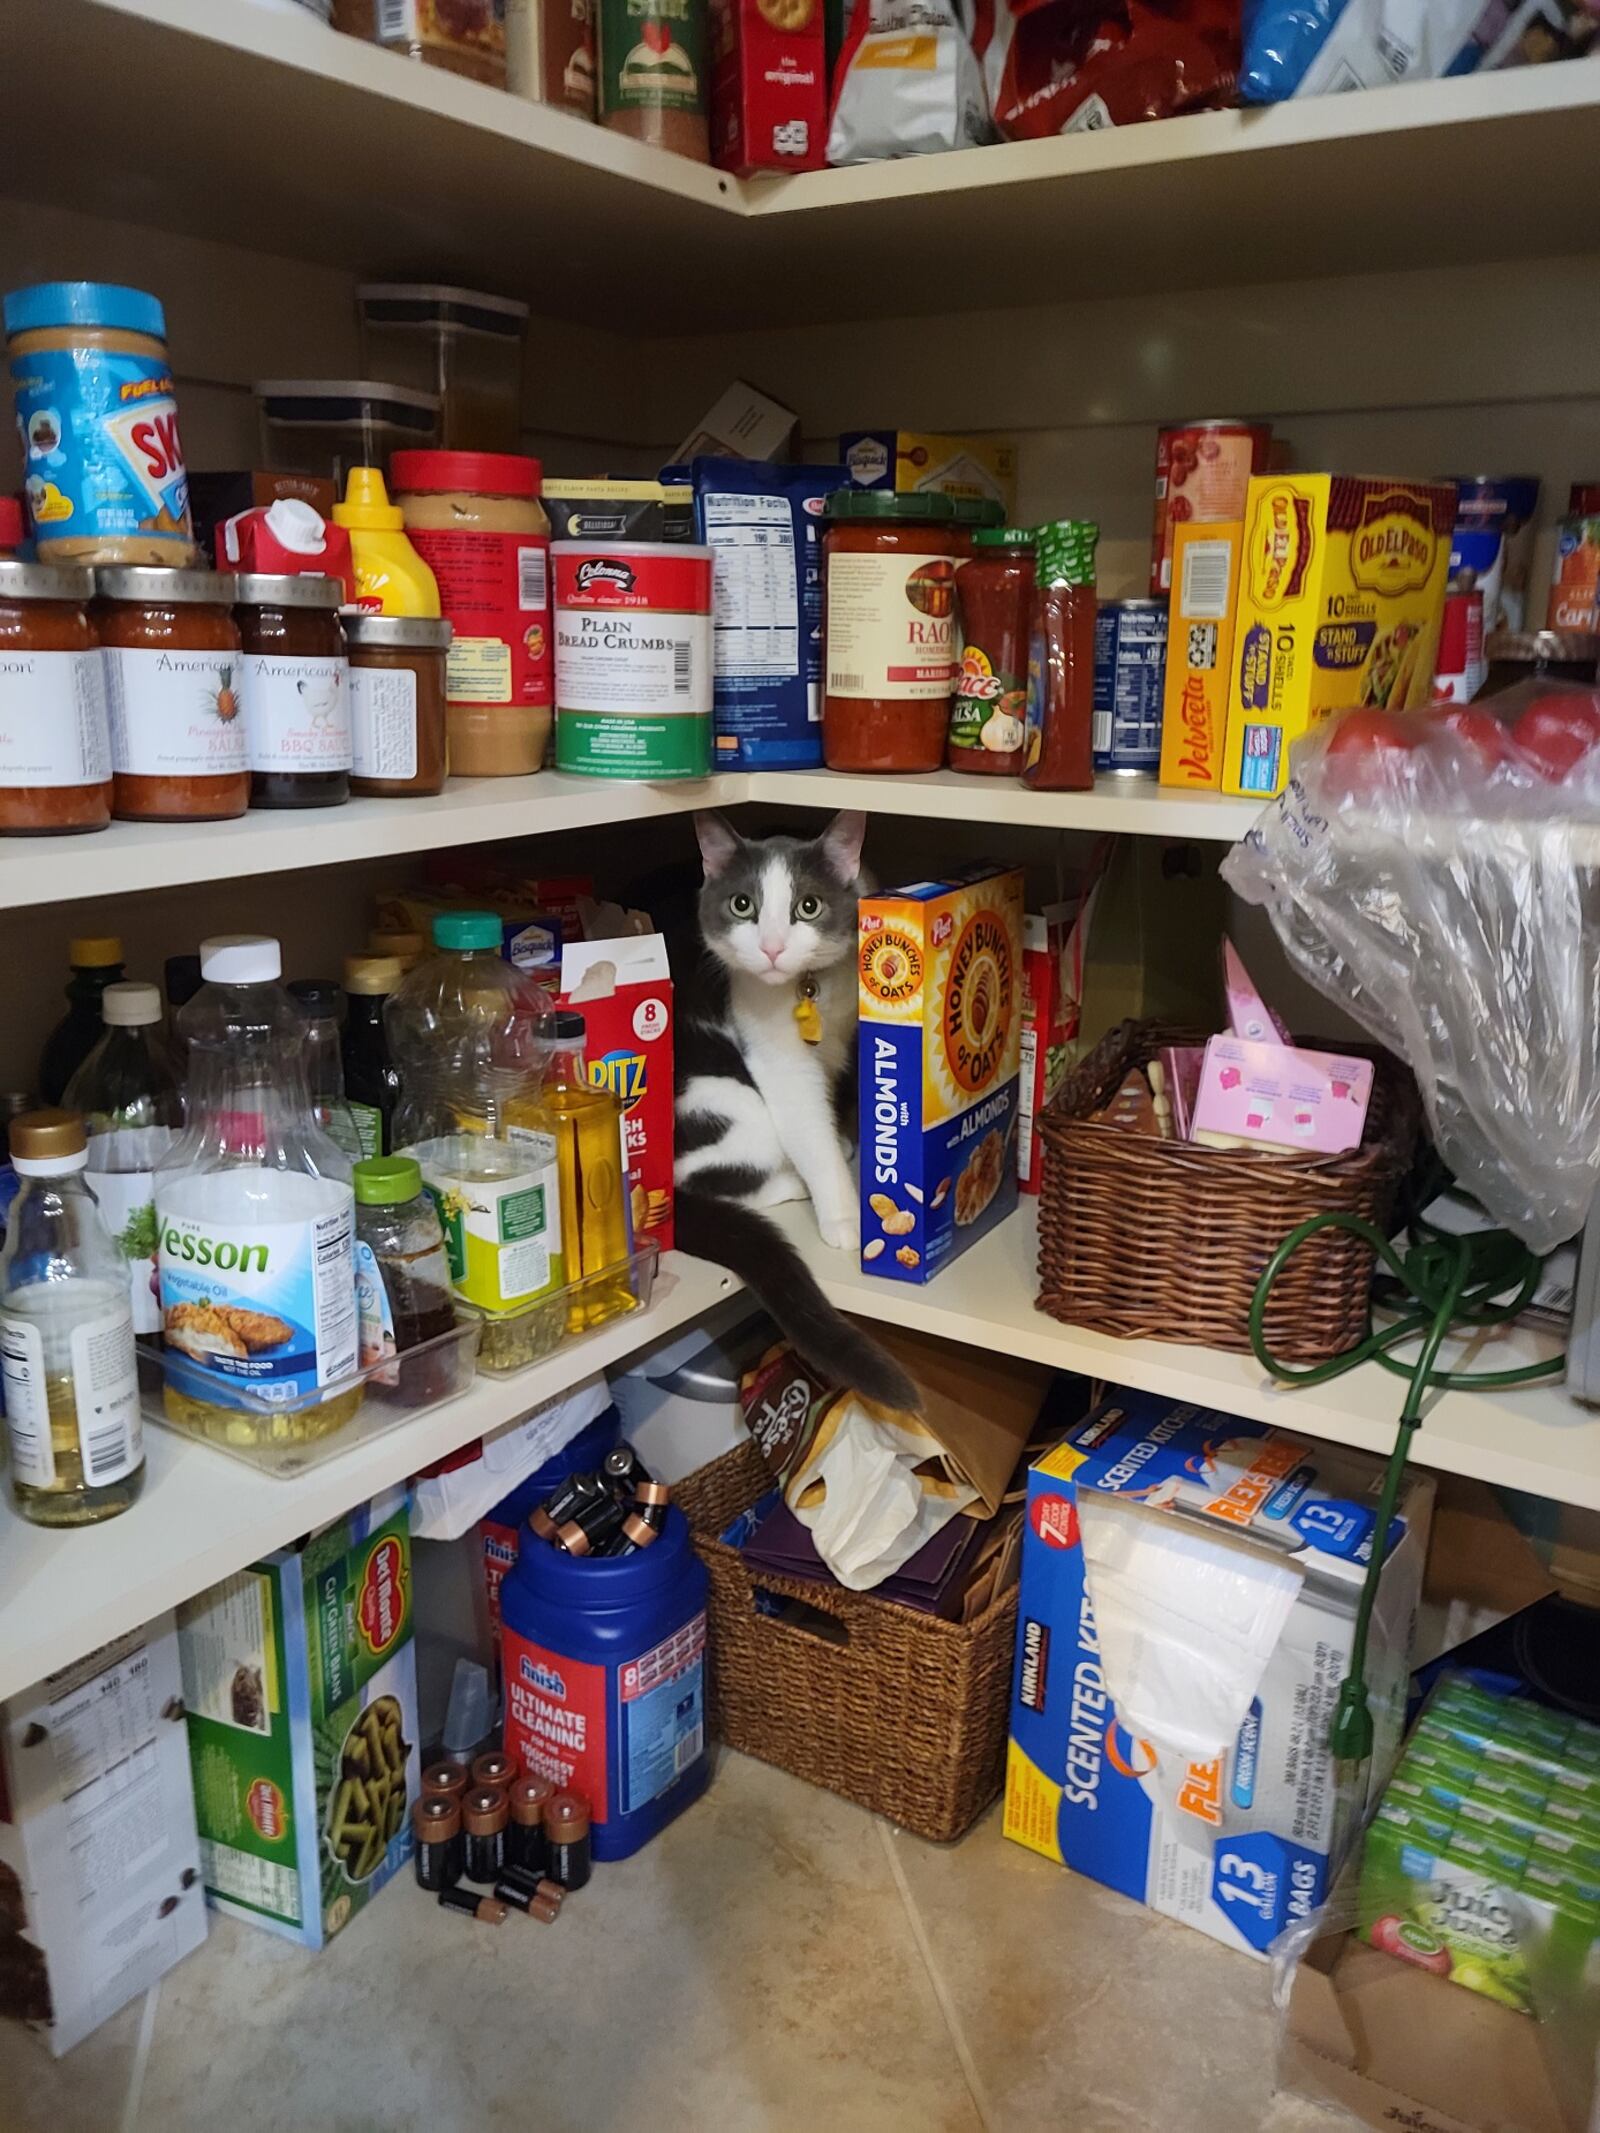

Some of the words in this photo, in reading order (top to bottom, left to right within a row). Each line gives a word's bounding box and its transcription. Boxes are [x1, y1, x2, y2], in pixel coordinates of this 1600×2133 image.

[120, 381, 157, 401] FUEL
[707, 496, 756, 507] Nutrition
[760, 497, 789, 508] Facts
[579, 560, 631, 580] Colonna
[581, 617, 633, 634] PLAIN
[1327, 596, 1345, 618] 10
[558, 632, 599, 649] BREAD
[603, 634, 675, 651] CRUMBS
[1276, 623, 1296, 652] 10
[1320, 628, 1357, 648] STAND
[1334, 643, 1365, 664] STUFF
[1256, 631, 1271, 686] STAND
[1271, 655, 1287, 712] SHELLS
[1177, 675, 1213, 782] Velveeta
[861, 915, 881, 932] Post
[932, 916, 952, 945] Post
[863, 935, 884, 972] HONEY
[885, 934, 921, 977] BUNCHES
[880, 981, 914, 998] OATS
[949, 932, 974, 1037] HONEY
[645, 1003, 656, 1022] 8
[971, 1025, 1005, 1084] OATS
[624, 1118, 643, 1134] SH
[874, 1037, 898, 1184] ALMONDS
[899, 1101, 909, 1127] with
[959, 1089, 1010, 1142] ALMONDS
[628, 1131, 647, 1148] KS
[167, 1272, 211, 1295] Vegetable
[212, 1286, 228, 1298] Oil
[1075, 1407, 1124, 1446] KIRKLAND
[1096, 1441, 1159, 1492] SCENTED
[1039, 1519, 1067, 1545] 7
[1298, 1503, 1345, 1535] 13
[484, 1536, 519, 1563] finis
[325, 1576, 337, 1606] CUT
[327, 1606, 339, 1655] GREEN
[378, 1582, 393, 1643] Monte
[1077, 1596, 1101, 1652] KIT
[330, 1655, 343, 1702] BEANS
[521, 1656, 566, 1699] finish
[624, 1667, 638, 1686] 8
[1021, 1620, 1042, 1707] KIRKLAND
[511, 1682, 586, 1731] ULTIMATE
[511, 1702, 586, 1752] CLEANING
[1063, 1660, 1108, 1811] SCENTED
[519, 1740, 575, 1776] TOUGHEST
[1179, 1755, 1223, 1823] FLE
[1217, 1852, 1264, 1907] 13
[1258, 1871, 1278, 1920] GALLON
[1288, 1860, 1317, 1917] BAGS
